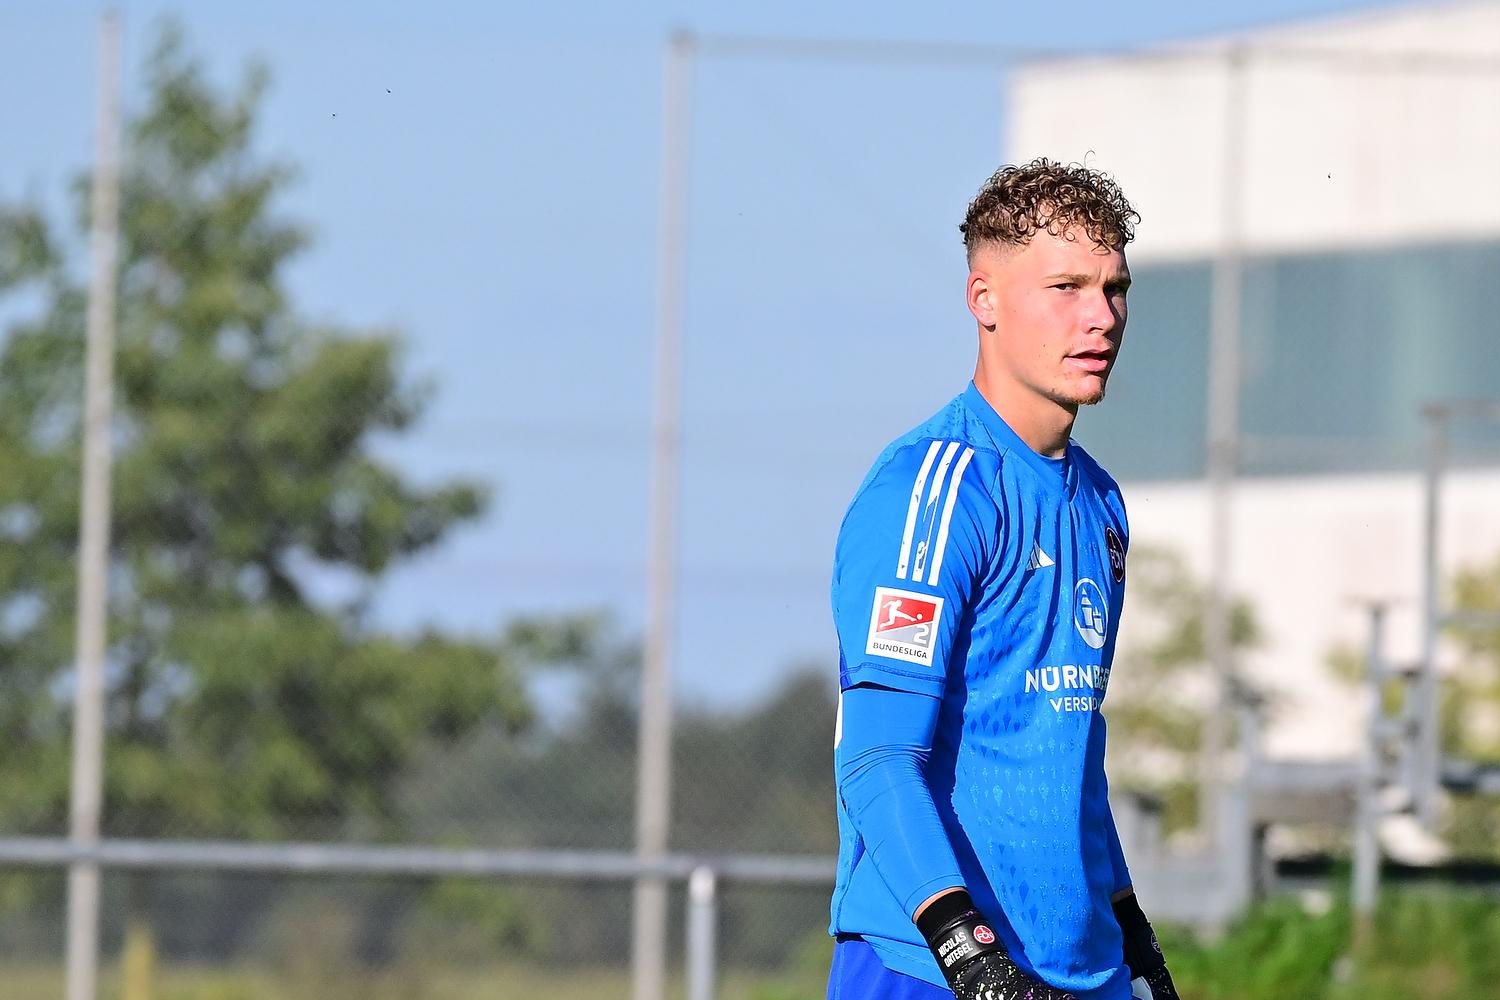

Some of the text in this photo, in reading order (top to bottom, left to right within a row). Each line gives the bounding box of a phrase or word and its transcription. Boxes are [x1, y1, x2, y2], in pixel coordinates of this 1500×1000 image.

[913, 624, 930, 645] 2
[873, 642, 928, 659] BUNDESLIGA
[938, 931, 967, 958] NICOLAS
[943, 942, 974, 968] ORTEGEL
